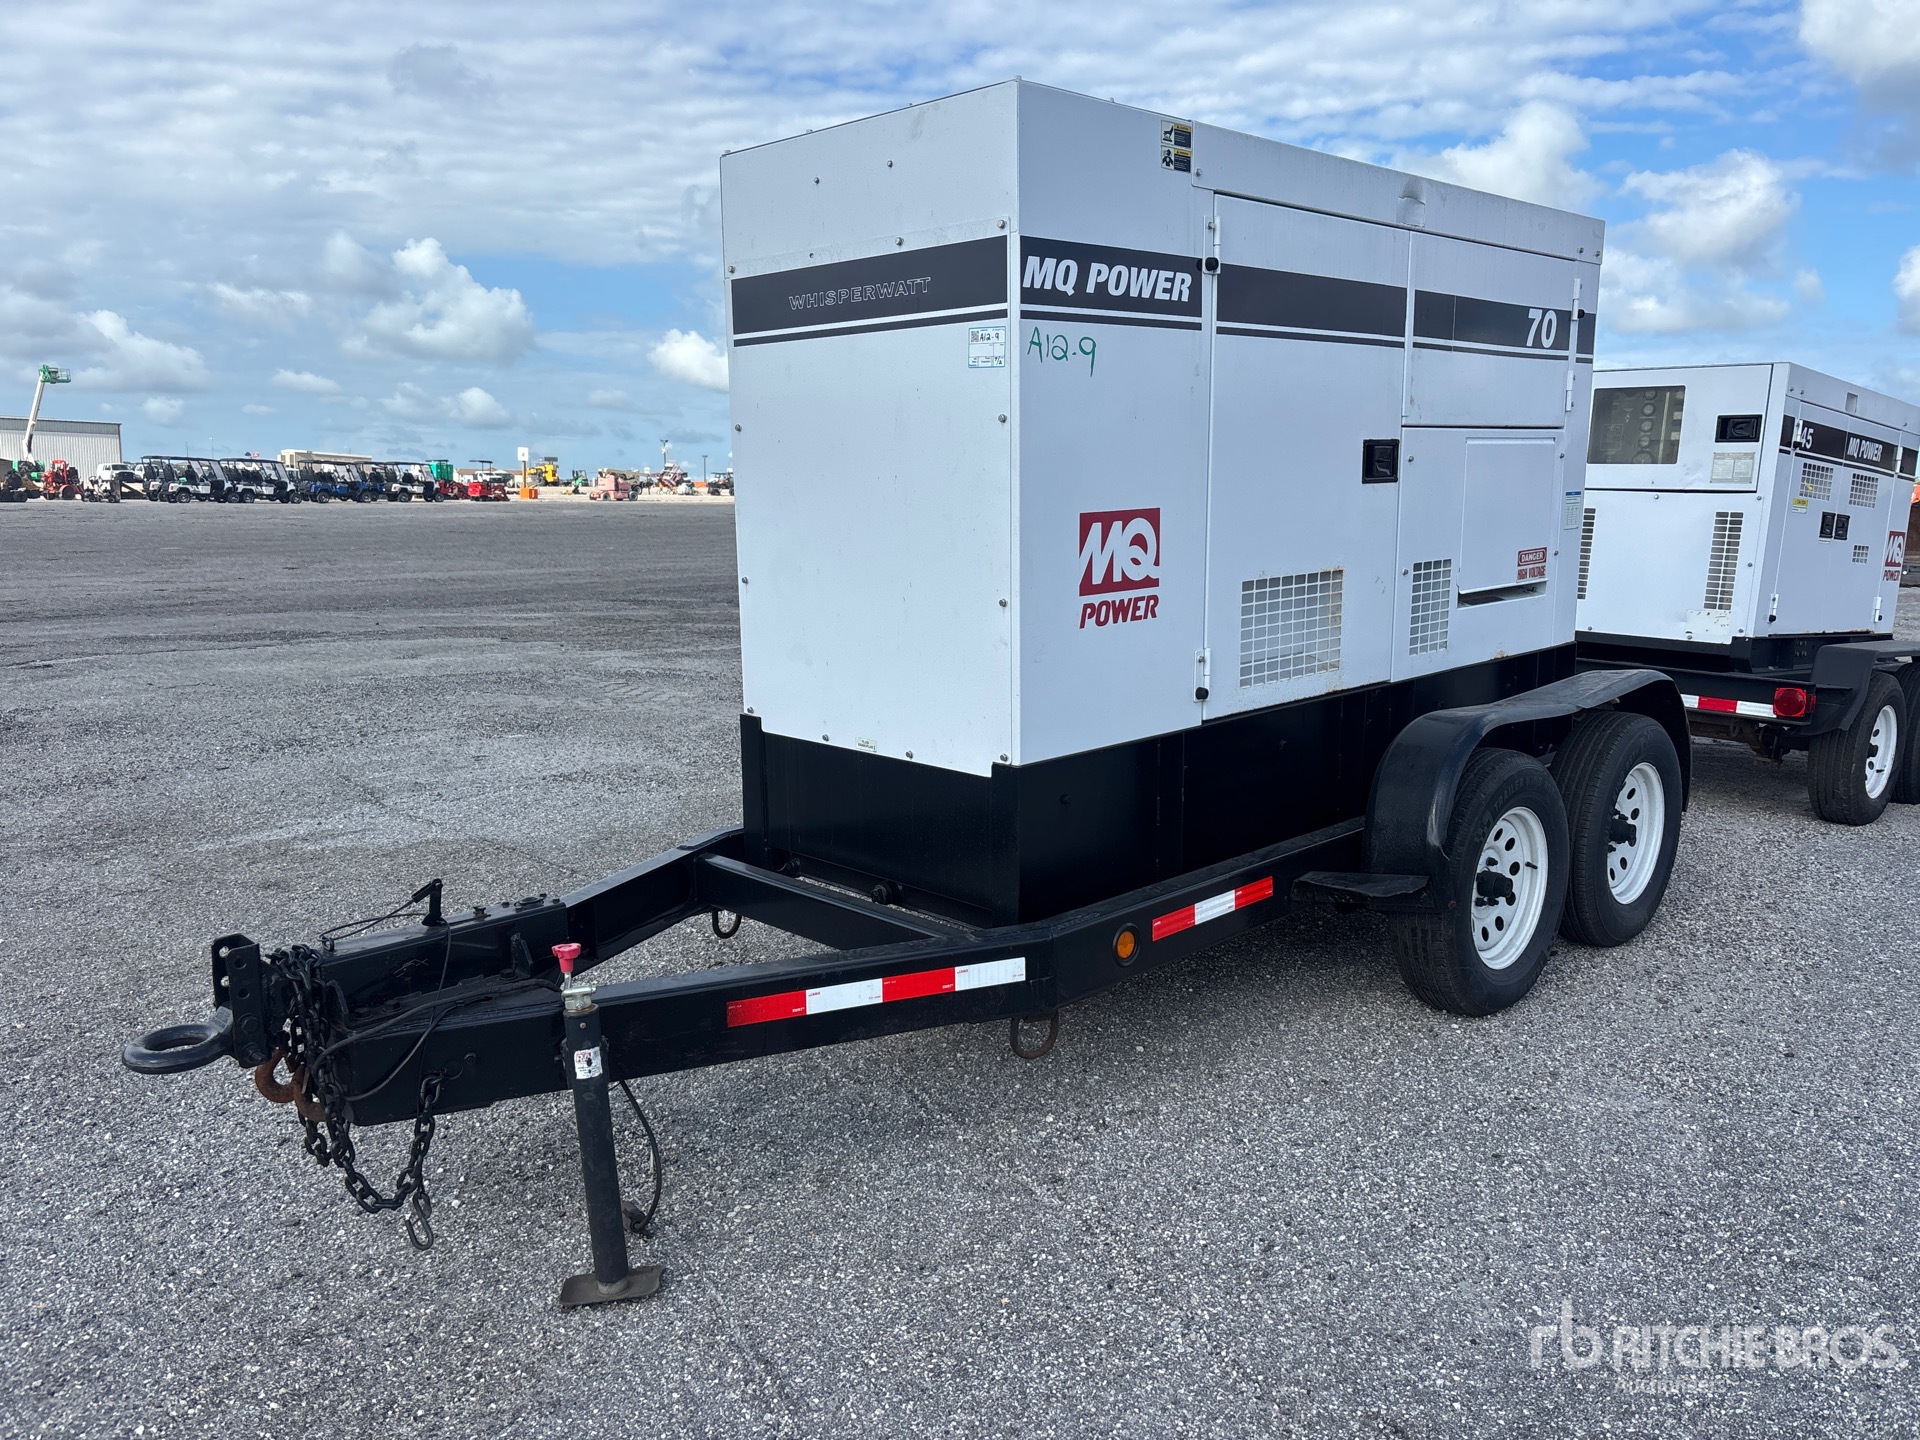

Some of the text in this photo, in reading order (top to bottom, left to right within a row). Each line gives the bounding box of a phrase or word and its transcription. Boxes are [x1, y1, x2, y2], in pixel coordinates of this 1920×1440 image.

[788, 276, 932, 311] WHISPERWATT
[1022, 255, 1193, 303] MQ POWER
[1526, 308, 1557, 349] 70
[1847, 437, 1883, 462] MQ POWER
[1079, 517, 1160, 585] MQ
[1521, 552, 1544, 562] DANGER
[1518, 566, 1545, 580] HIGH VOLTAGE
[1079, 594, 1159, 629] POWER
